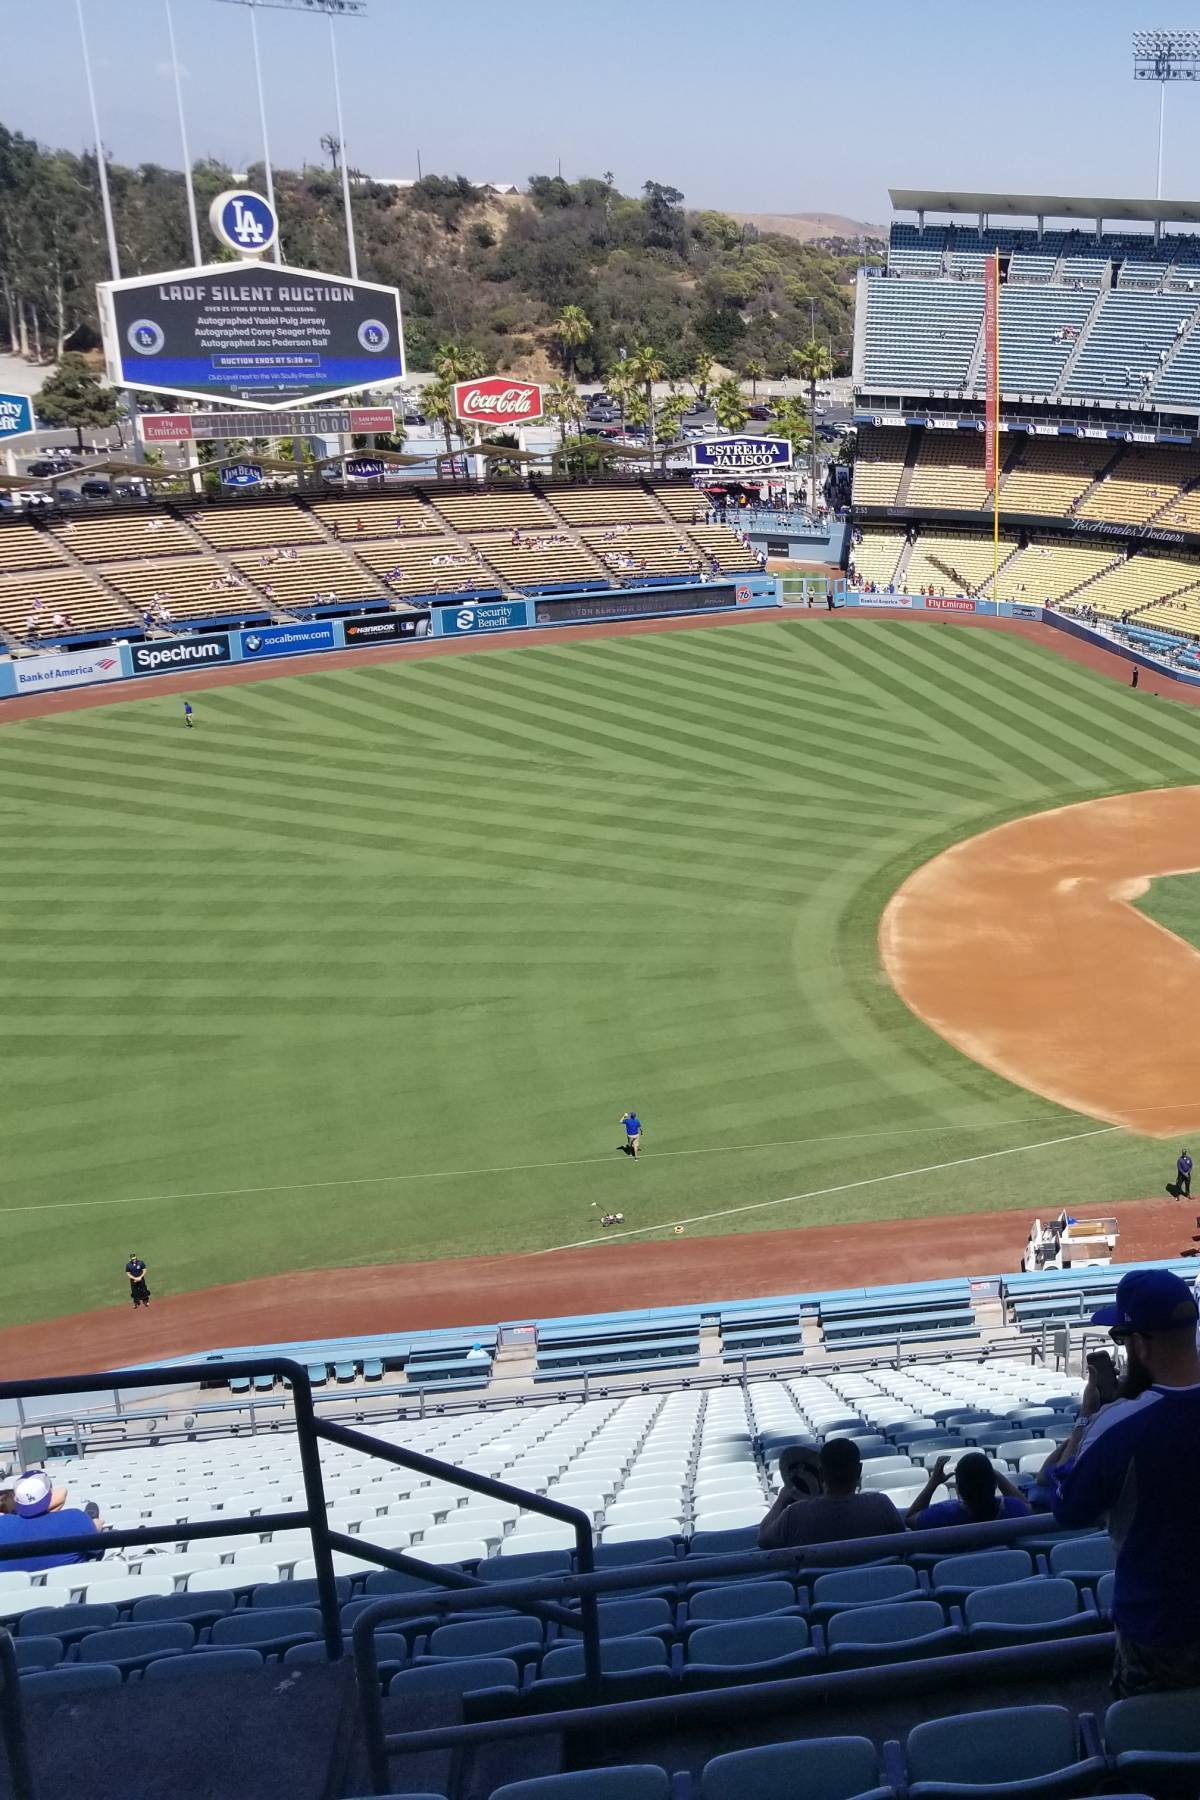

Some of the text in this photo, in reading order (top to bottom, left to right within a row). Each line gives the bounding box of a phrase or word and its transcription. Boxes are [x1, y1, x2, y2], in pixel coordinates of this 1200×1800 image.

[232, 200, 263, 242] LA
[160, 286, 354, 301] LADF SILENT AUCTION
[198, 317, 325, 326] Autographed Yasiel Puig Jersey
[195, 328, 250, 337] Autographed
[251, 328, 275, 337] Corey
[277, 328, 305, 337] Seager
[201, 340, 255, 348] Autographed
[464, 389, 534, 414] Coca-Cola
[1018, 394, 1100, 408] STADIUM
[1115, 401, 1156, 412] CLUB
[160, 420, 173, 428] Fly
[148, 426, 189, 437] Emirates
[705, 444, 780, 456] ESTRELLA
[714, 455, 773, 466] JALISCO
[348, 463, 384, 474] DASANI
[1068, 518, 1185, 543] Los Angeles Dodgers
[737, 591, 749, 599] 76
[928, 599, 941, 609] Fly
[942, 600, 974, 610] Emirates
[477, 607, 512, 618] Security
[477, 616, 509, 628] Benefit
[264, 630, 330, 647] socalbmw.com
[137, 643, 220, 668] Spectrum
[19, 665, 93, 684] Bank of America
